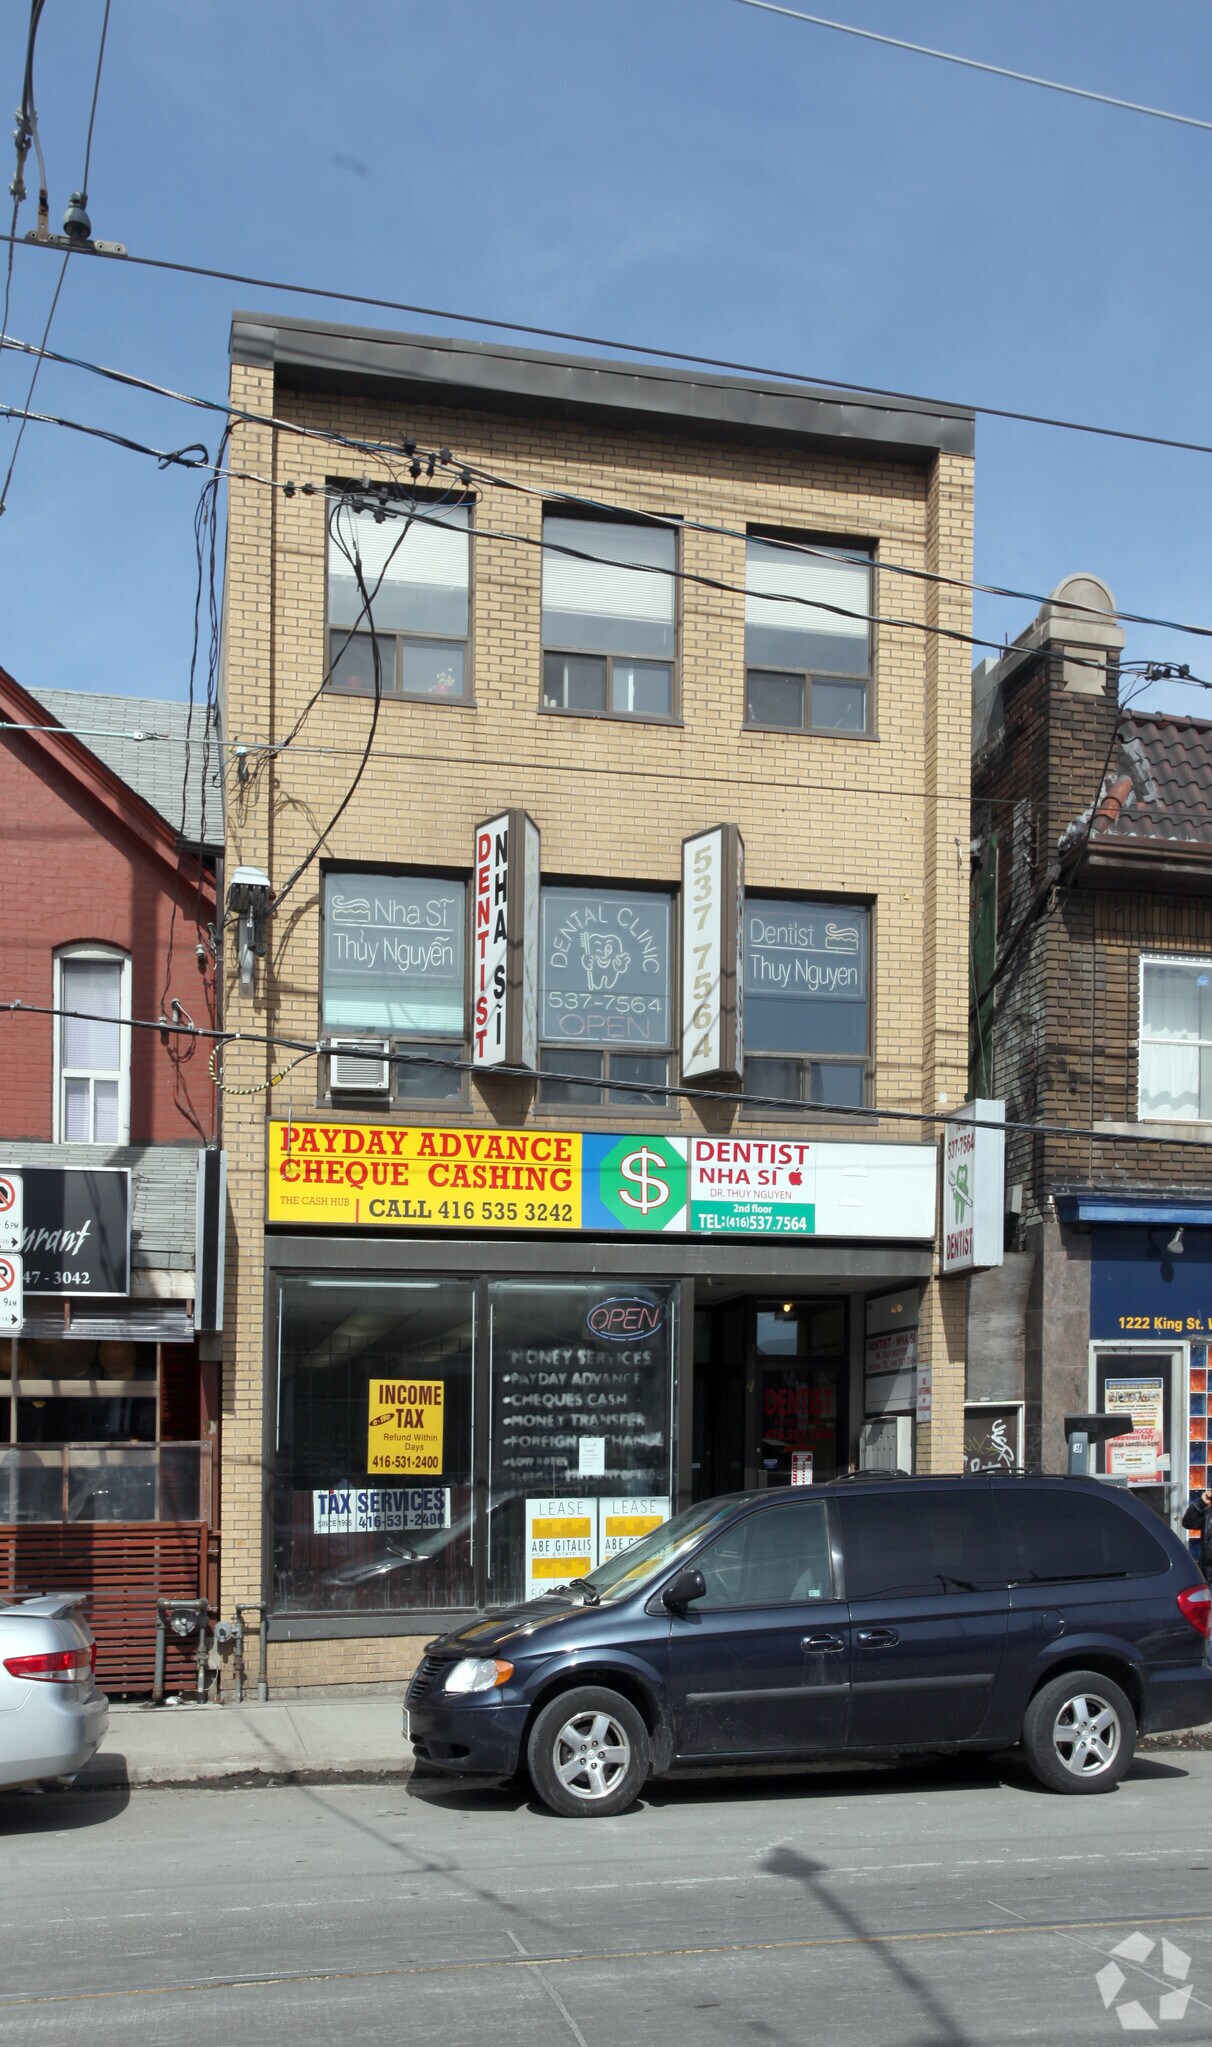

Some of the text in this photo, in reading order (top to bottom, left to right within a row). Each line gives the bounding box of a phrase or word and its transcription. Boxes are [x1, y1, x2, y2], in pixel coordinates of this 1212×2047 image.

[493, 830, 508, 945] NHA
[375, 899, 420, 925] Nha
[550, 905, 660, 974] DENTAL CLINIC
[750, 918, 815, 947] Dentist
[476, 832, 492, 1059] DENTIST
[692, 845, 713, 1060] 537 7564
[750, 954, 858, 991] Thuy Nguyen
[548, 991, 662, 1014] 537-7564
[559, 1013, 650, 1038] OPEN
[280, 1126, 573, 1163] PAYDAY ADVANCE
[695, 1140, 810, 1166] DENTIST
[948, 1132, 975, 1160] 537-7564
[279, 1158, 573, 1193] CHEQUE CASHING
[699, 1167, 751, 1186] NHA
[279, 1195, 350, 1207] THE CASH HUB
[710, 1188, 792, 1200] DR. THUY NGUYEN
[368, 1198, 573, 1222] CALL 416 535 3242
[733, 1204, 773, 1213] 2nd floor
[946, 1226, 974, 1261] DENTIST
[53, 1270, 91, 1285] 3042
[590, 1307, 660, 1330] OPEN
[1118, 1316, 1151, 1329] 1222
[1153, 1316, 1183, 1332] King
[1186, 1317, 1205, 1330] St.
[510, 1349, 573, 1366] MONEY
[511, 1371, 568, 1386] PAYDAY
[378, 1384, 442, 1407] INCOME
[511, 1392, 628, 1408] CHEQUES CASH
[764, 1387, 834, 1417] DENTIST
[395, 1408, 425, 1429] TAX
[383, 1433, 438, 1441] Refund Within
[404, 1442, 425, 1452] Days
[317, 1490, 446, 1515] TAX SERVICES
[538, 1500, 585, 1516] LEASE
[612, 1499, 657, 1514] LEASE
[317, 1520, 337, 1528] SINCE
[531, 1539, 592, 1552] ABE GITALIS
[605, 1538, 623, 1550] ABE
